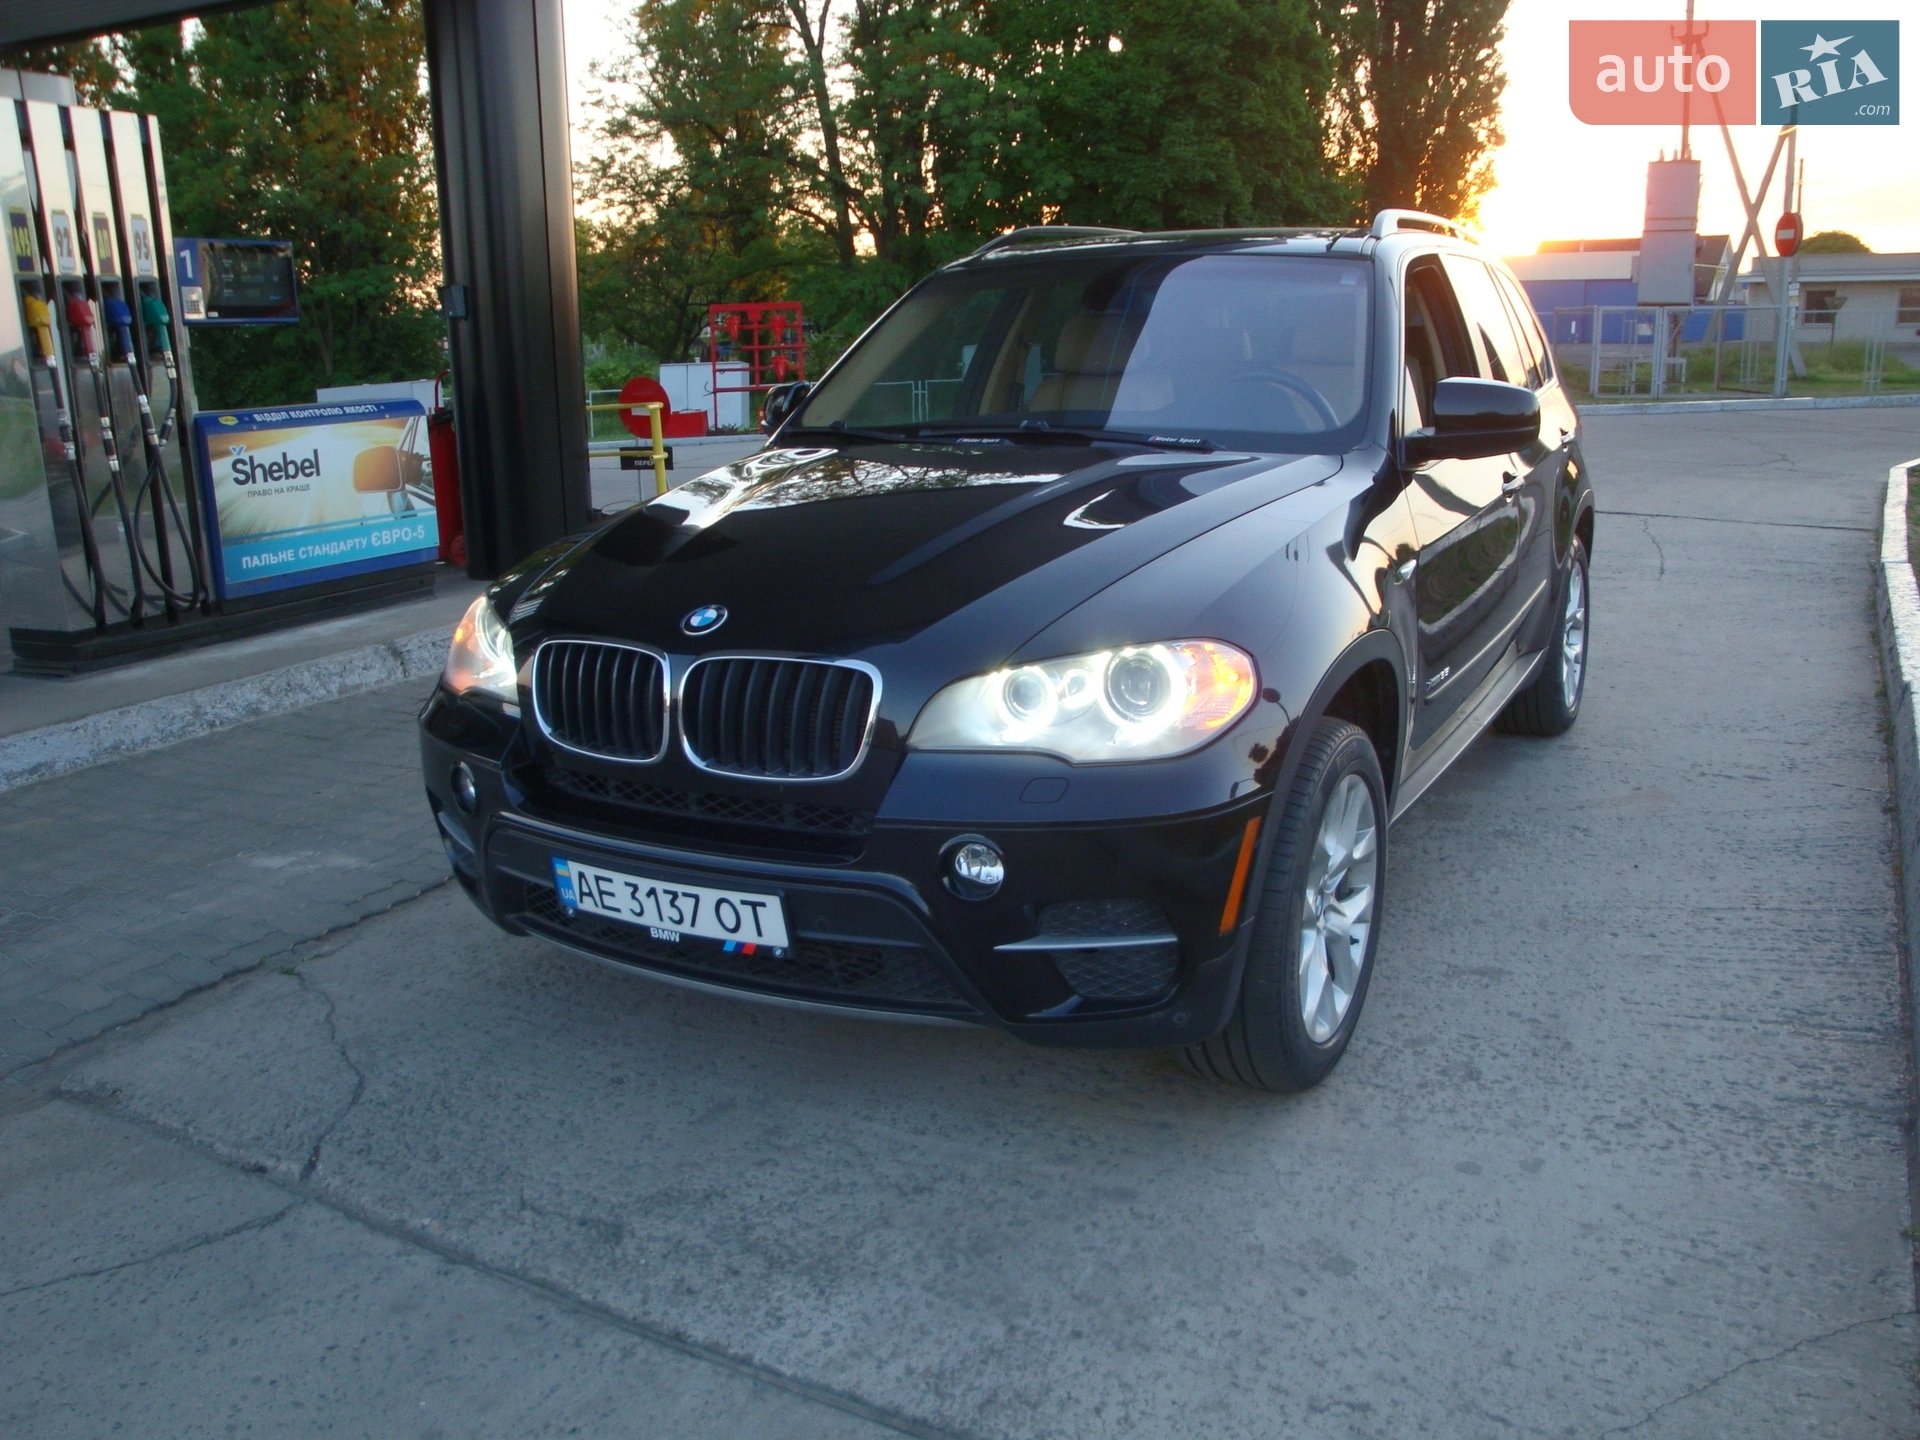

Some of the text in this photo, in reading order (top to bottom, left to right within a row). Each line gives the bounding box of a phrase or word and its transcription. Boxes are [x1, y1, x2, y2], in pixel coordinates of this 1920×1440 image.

[55, 226, 73, 257] 92
[134, 230, 150, 260] 95
[180, 249, 193, 278] 1
[253, 405, 378, 422] ВІДДІЛ КОНТРОЛЮ ЯКОСТІ
[247, 486, 273, 498] ПРАВО
[286, 483, 311, 494] КРАЩЕ
[242, 525, 425, 570] ПАЛЬНЕ СТАНДАРТУ ЄВРО-5
[561, 887, 576, 902] UA
[577, 870, 768, 938] AE 3137 OT
[650, 926, 680, 943] BMW
